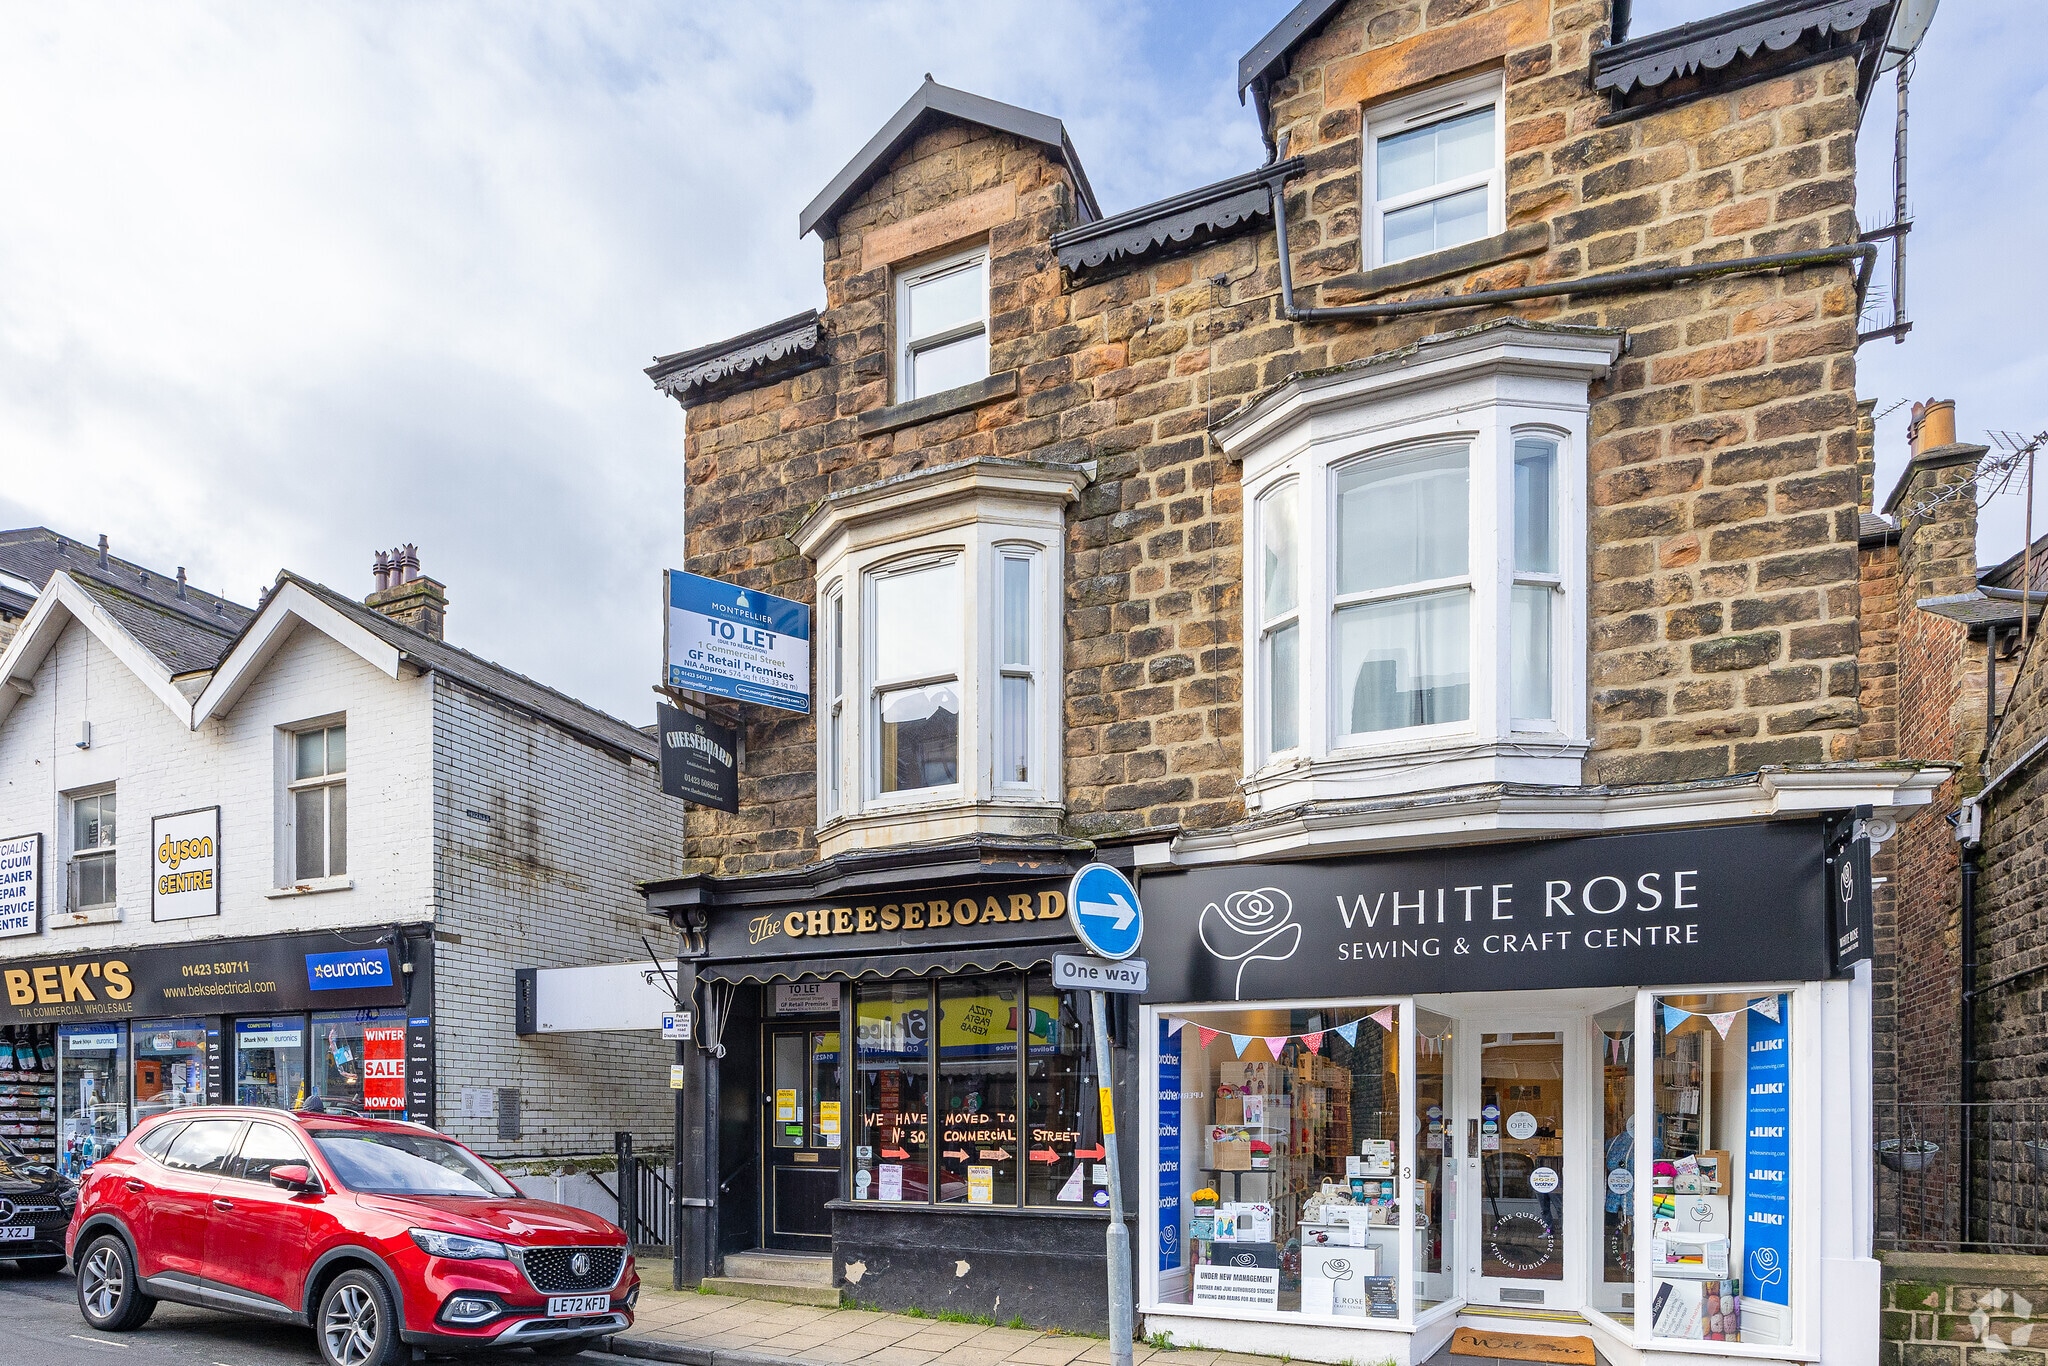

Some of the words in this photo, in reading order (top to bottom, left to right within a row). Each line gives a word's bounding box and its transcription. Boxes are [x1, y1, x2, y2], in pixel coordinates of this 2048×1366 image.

[712, 602, 772, 624] MONTPELLIER
[708, 618, 734, 640] TO
[743, 627, 776, 650] LET
[706, 642, 758, 661] Commercial
[760, 656, 785, 668] Street
[738, 642, 767, 654] RELOCATION)
[684, 659, 698, 668] NIA
[700, 664, 727, 675] Approx
[759, 676, 779, 687] (53.33
[689, 649, 704, 660] GF
[708, 654, 740, 669] Retail
[744, 662, 794, 681] Premises
[666, 731, 732, 768] CHEESEBOARD
[158, 834, 213, 870] dyson
[158, 869, 212, 895] CENTRE
[1336, 884, 1514, 930] WHITE
[1545, 870, 1699, 918] ROSE
[749, 912, 782, 945] The
[782, 890, 1066, 937] CHEESEBOARD
[1338, 937, 1440, 962] SEWING
[1453, 938, 1470, 956] &
[1483, 930, 1572, 954] CRAFT
[1584, 924, 1699, 950] CENTRE
[182, 964, 212, 977] 01423
[214, 960, 249, 974] 530711
[323, 958, 384, 978] euronics
[1063, 962, 1098, 978] One
[1105, 969, 1140, 984] way
[4, 960, 133, 1006] BEK'S
[163, 980, 276, 998] www.bekselectrical.com
[789, 985, 801, 993] TO
[804, 984, 820, 993] LET
[19, 1008, 32, 1018] T/A
[33, 1005, 83, 1018] COMMERCIAL
[84, 1002, 133, 1016] WHOLESALE
[366, 1030, 404, 1041] WINTER
[1750, 1039, 1783, 1052] JUKI
[366, 1062, 404, 1076] SALE
[1750, 1083, 1783, 1094] JUKI
[365, 1097, 388, 1107] NOW
[390, 1097, 404, 1107] ON
[864, 1113, 883, 1126] WE
[896, 1114, 928, 1126] HAVE
[945, 1114, 989, 1126] MOVED
[997, 1113, 1015, 1123] TO
[911, 1130, 926, 1143] 30
[1032, 1129, 1080, 1142] STREET
[1750, 1127, 1782, 1137] JUKI
[1404, 1167, 1411, 1179] 3
[1749, 1170, 1782, 1181] JUKI
[1498, 1214, 1513, 1225] THE
[1516, 1212, 1548, 1228] QUEENS
[1749, 1212, 1782, 1225] JUKI
[7, 1228, 29, 1238] XZJ
[574, 1256, 589, 1271] MG
[1518, 1254, 1550, 1271] JUBILEE
[1233, 1274, 1272, 1283] MANAGEMENT
[553, 1299, 584, 1312] LE72
[585, 1297, 605, 1310] KFD
